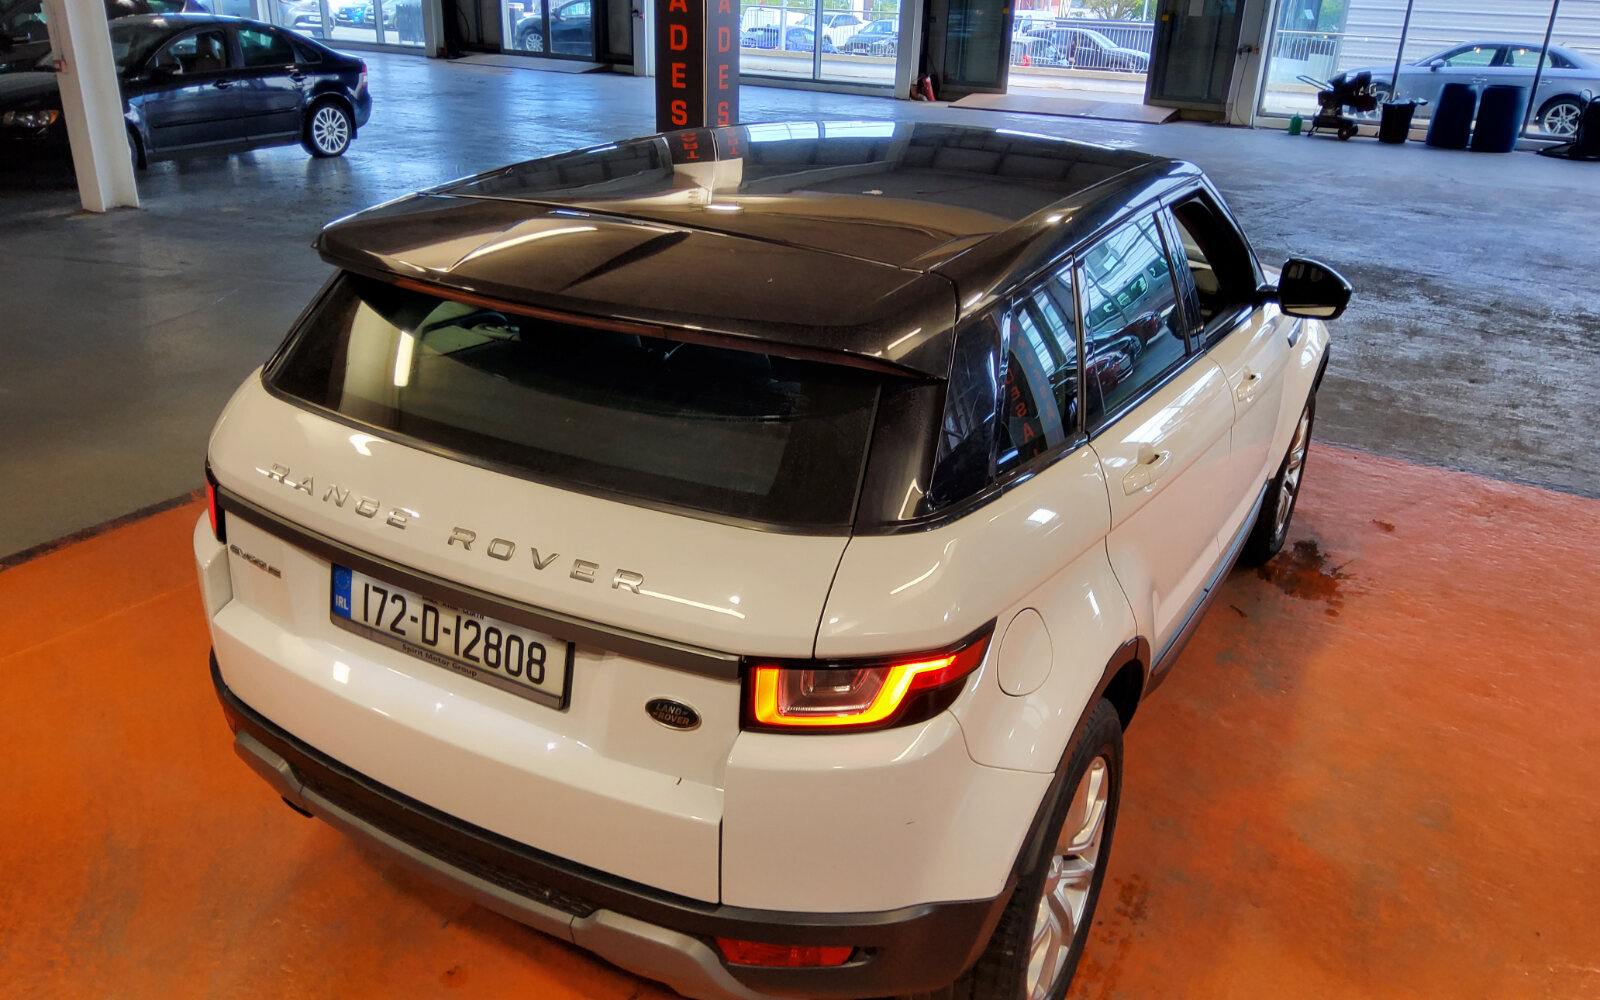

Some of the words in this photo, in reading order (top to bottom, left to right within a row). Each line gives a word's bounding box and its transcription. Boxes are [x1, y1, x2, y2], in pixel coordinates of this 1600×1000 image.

[268, 463, 408, 530] RANGE
[447, 526, 644, 595] ROVER
[335, 595, 349, 611] IRL
[363, 582, 547, 686] 172-D-12808
[402, 643, 423, 656] Spirit
[425, 651, 451, 667] Motor
[452, 662, 478, 678] Group
[656, 703, 682, 716] LAND
[657, 711, 690, 726] ROVER
